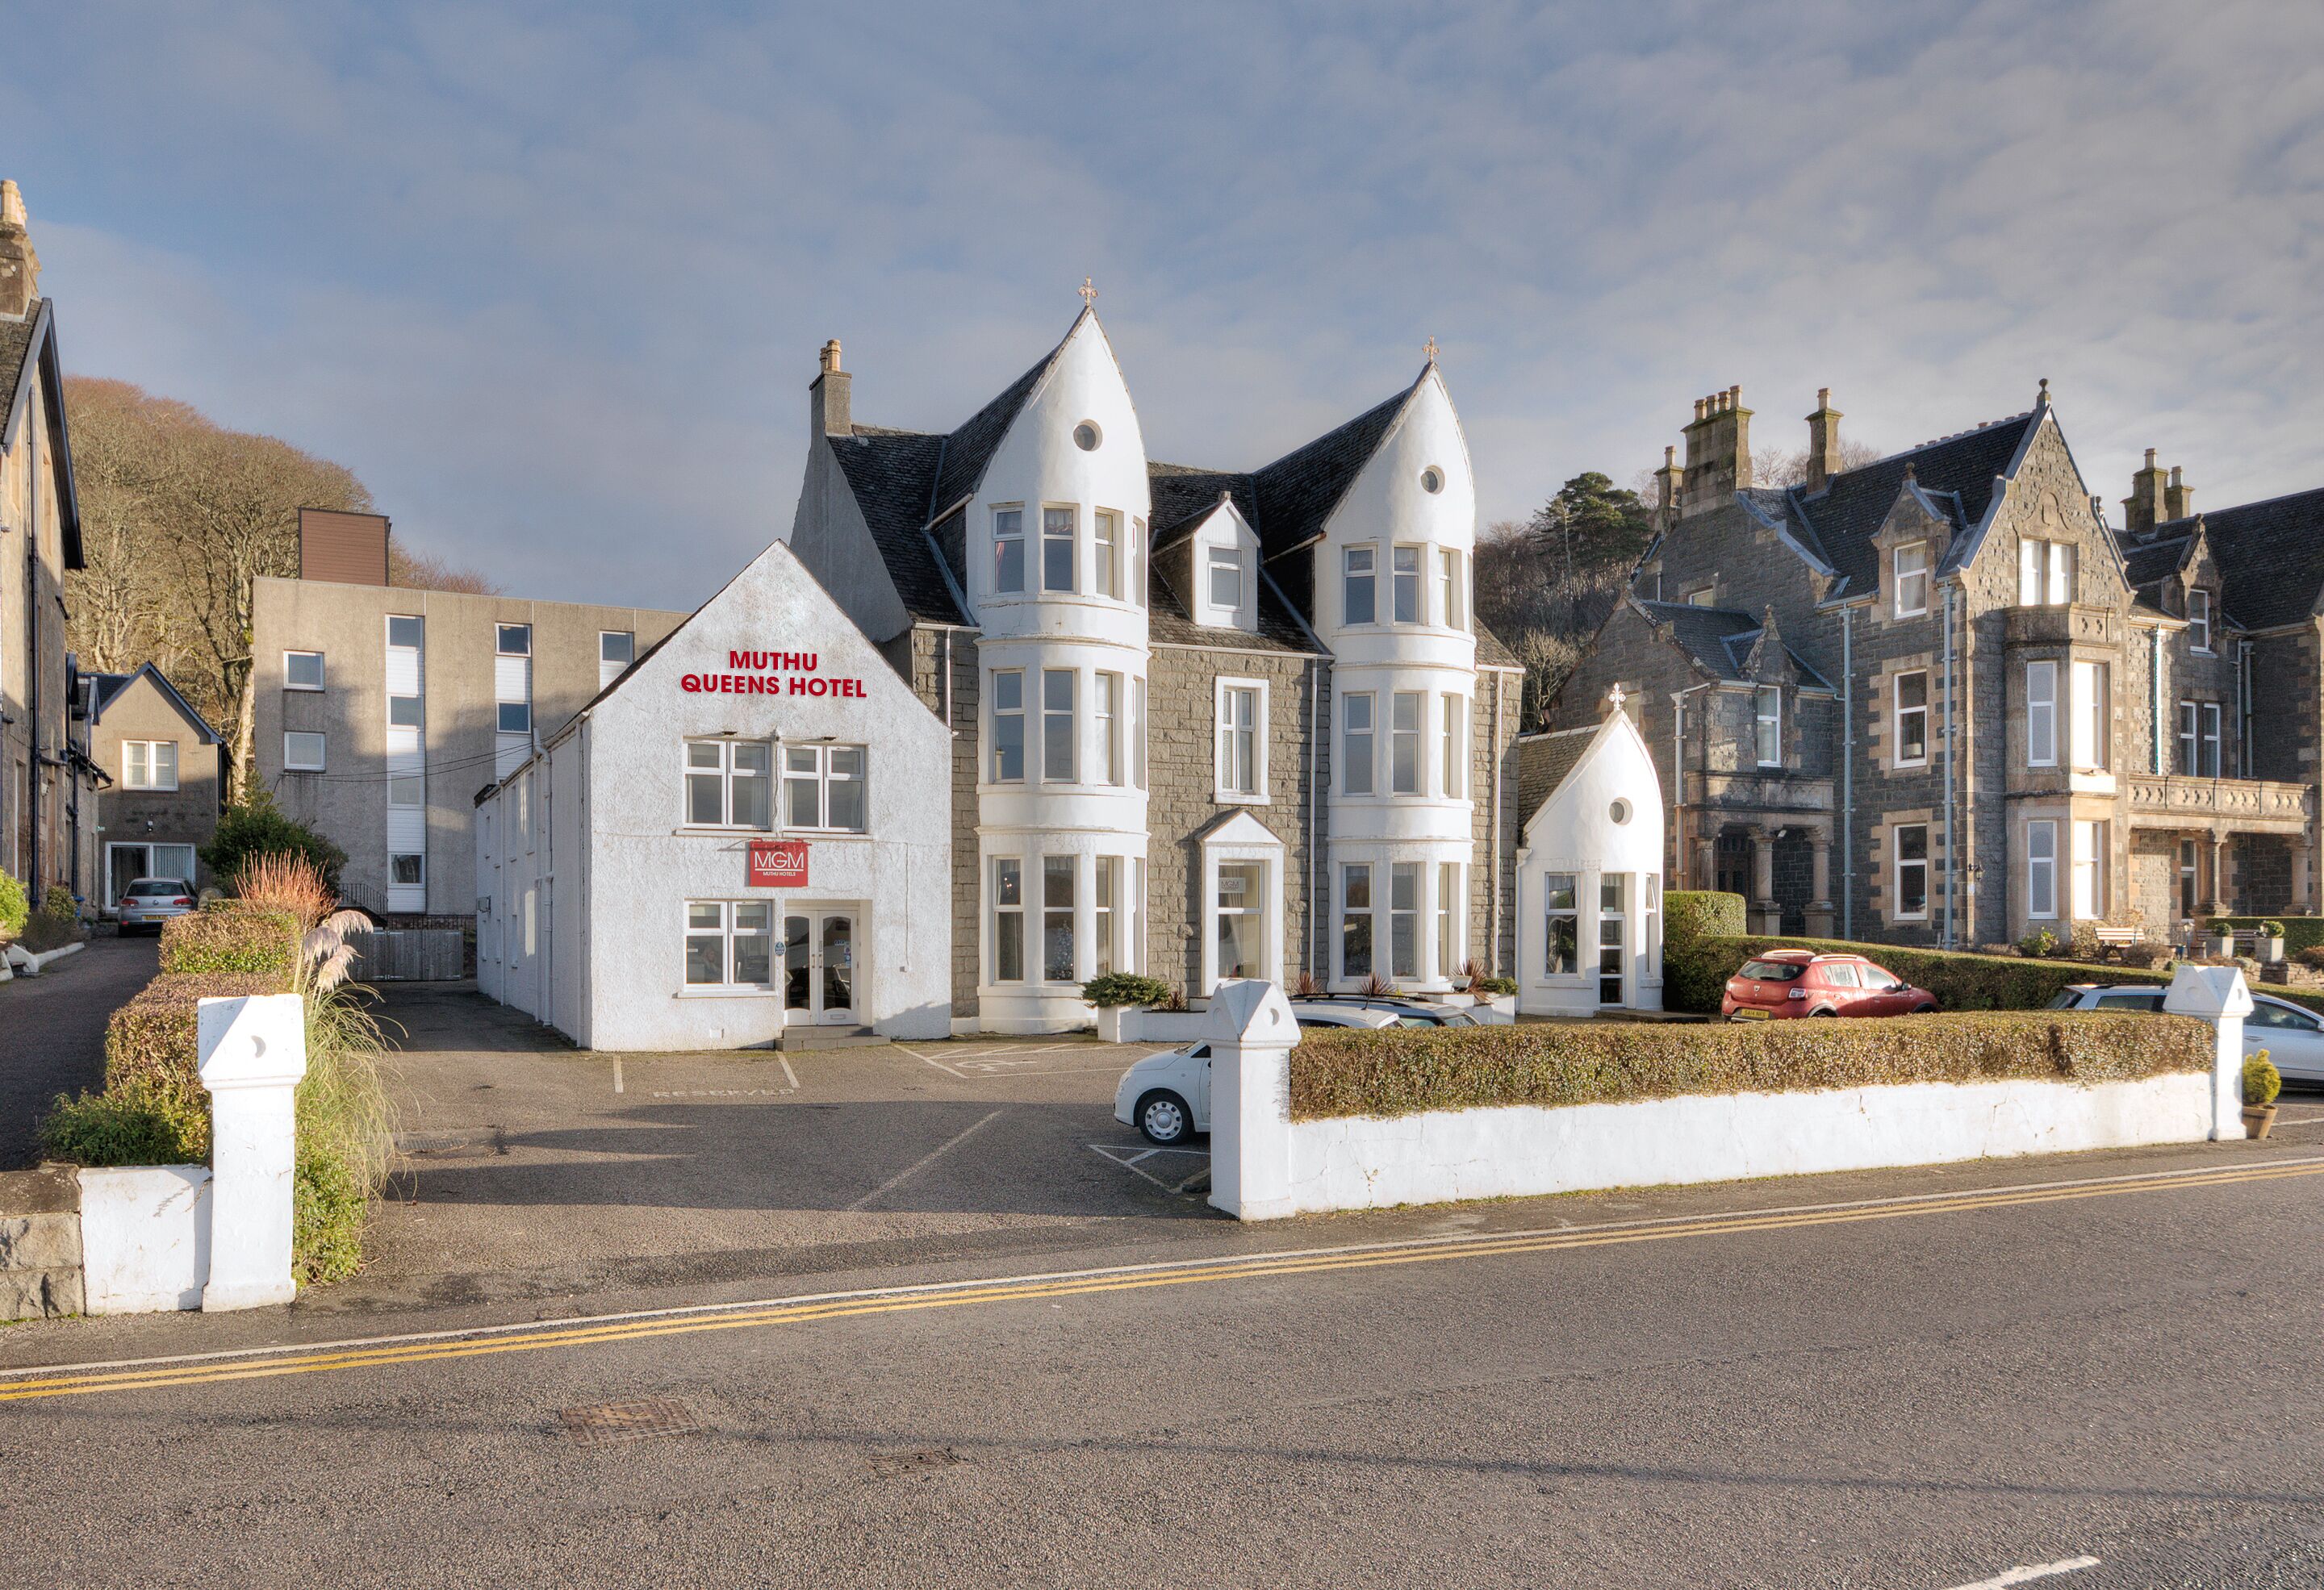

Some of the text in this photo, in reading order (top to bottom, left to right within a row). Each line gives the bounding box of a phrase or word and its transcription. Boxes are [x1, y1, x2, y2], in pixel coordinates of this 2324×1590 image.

[729, 650, 817, 671] MUTHU
[681, 674, 867, 698] QUEENS HOTEL
[754, 852, 804, 869] MGM
[1221, 880, 1239, 888] MGM
[652, 1088, 794, 1098] RESERVED
